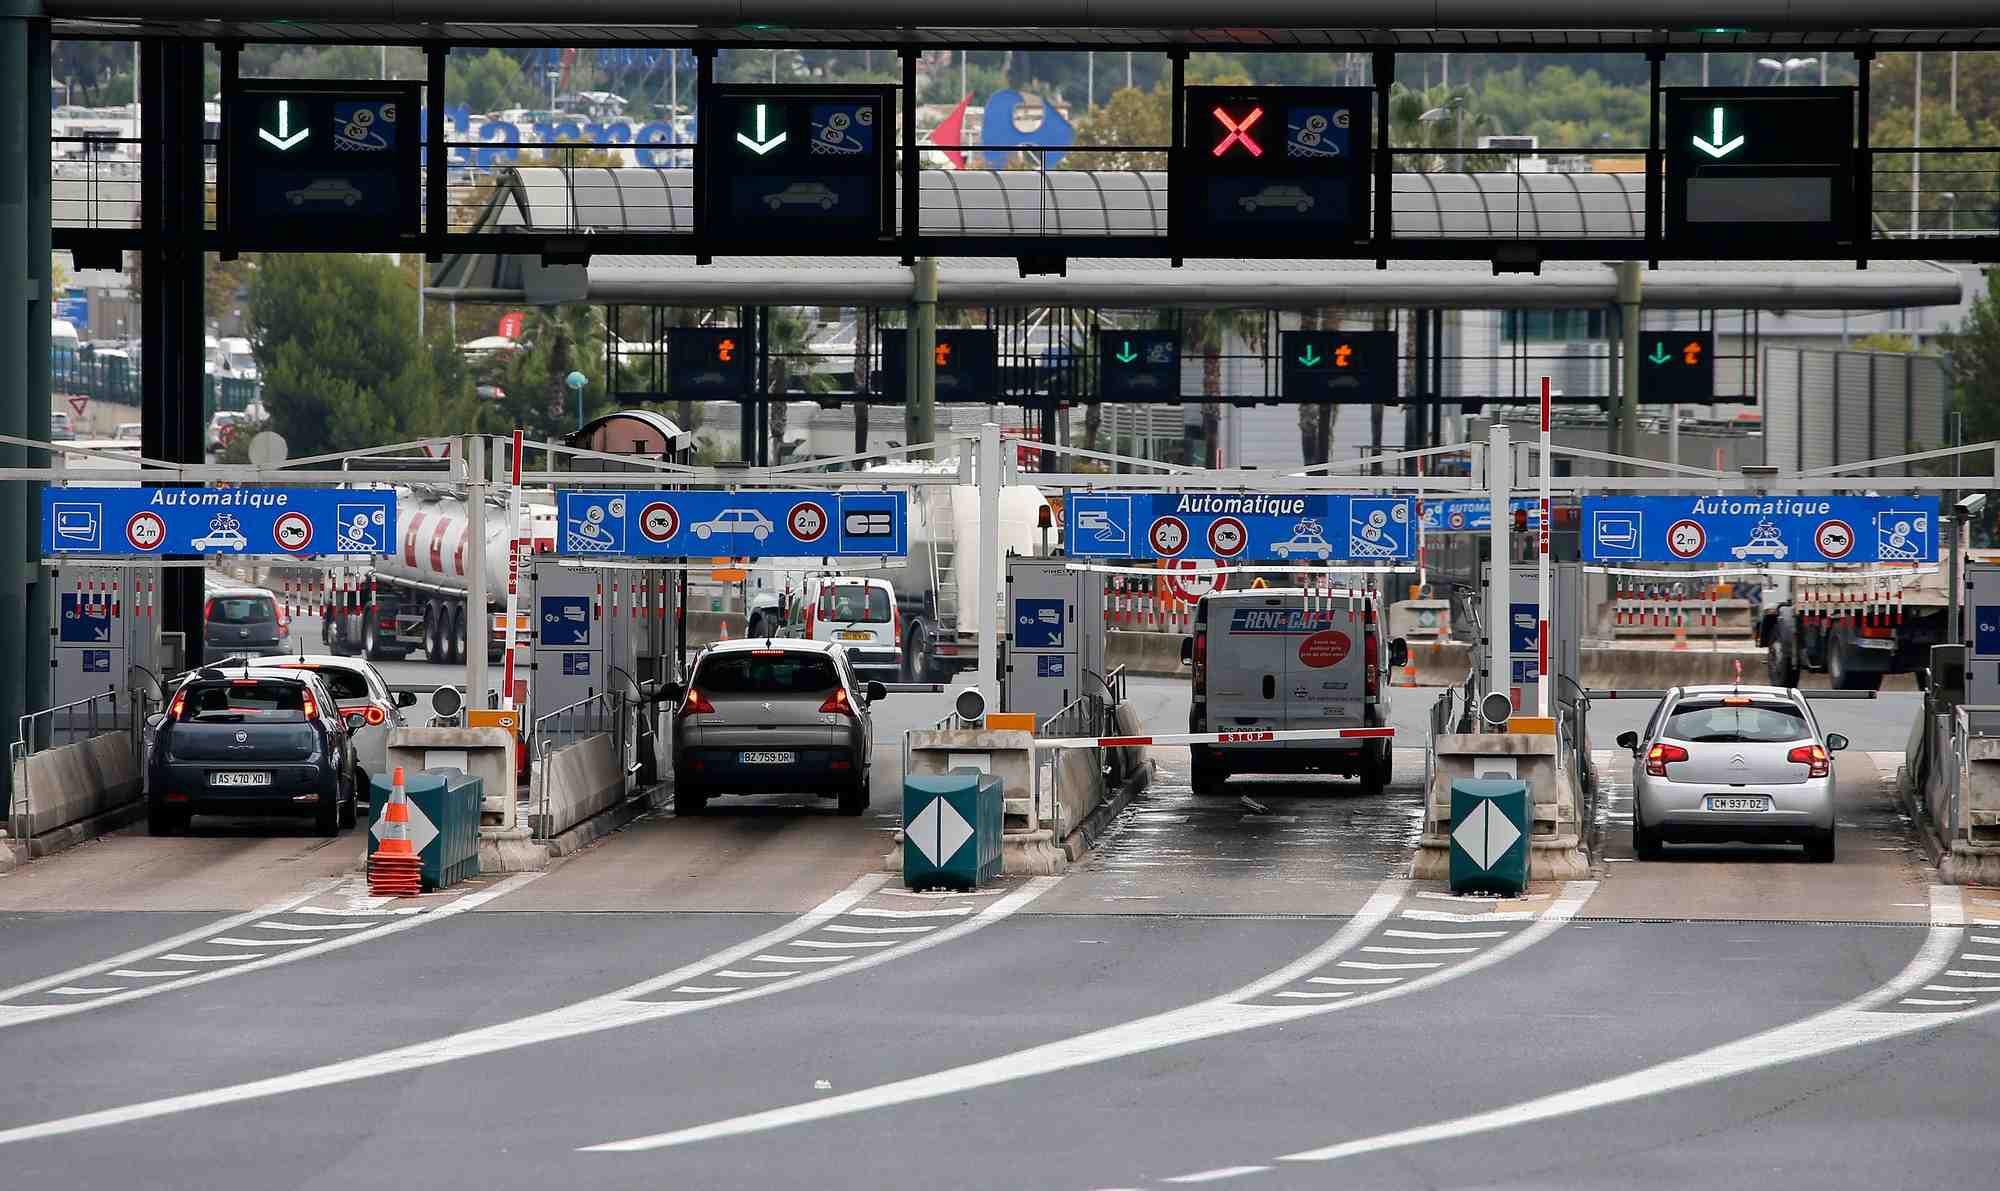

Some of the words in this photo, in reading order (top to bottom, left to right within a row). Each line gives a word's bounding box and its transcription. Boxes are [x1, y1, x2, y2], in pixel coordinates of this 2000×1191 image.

[150, 489, 288, 507] Automatique
[1176, 494, 1305, 516] Automatique
[1693, 498, 1831, 517] Automatique
[1245, 611, 1284, 628] RENT
[1227, 732, 1265, 742] STOP
